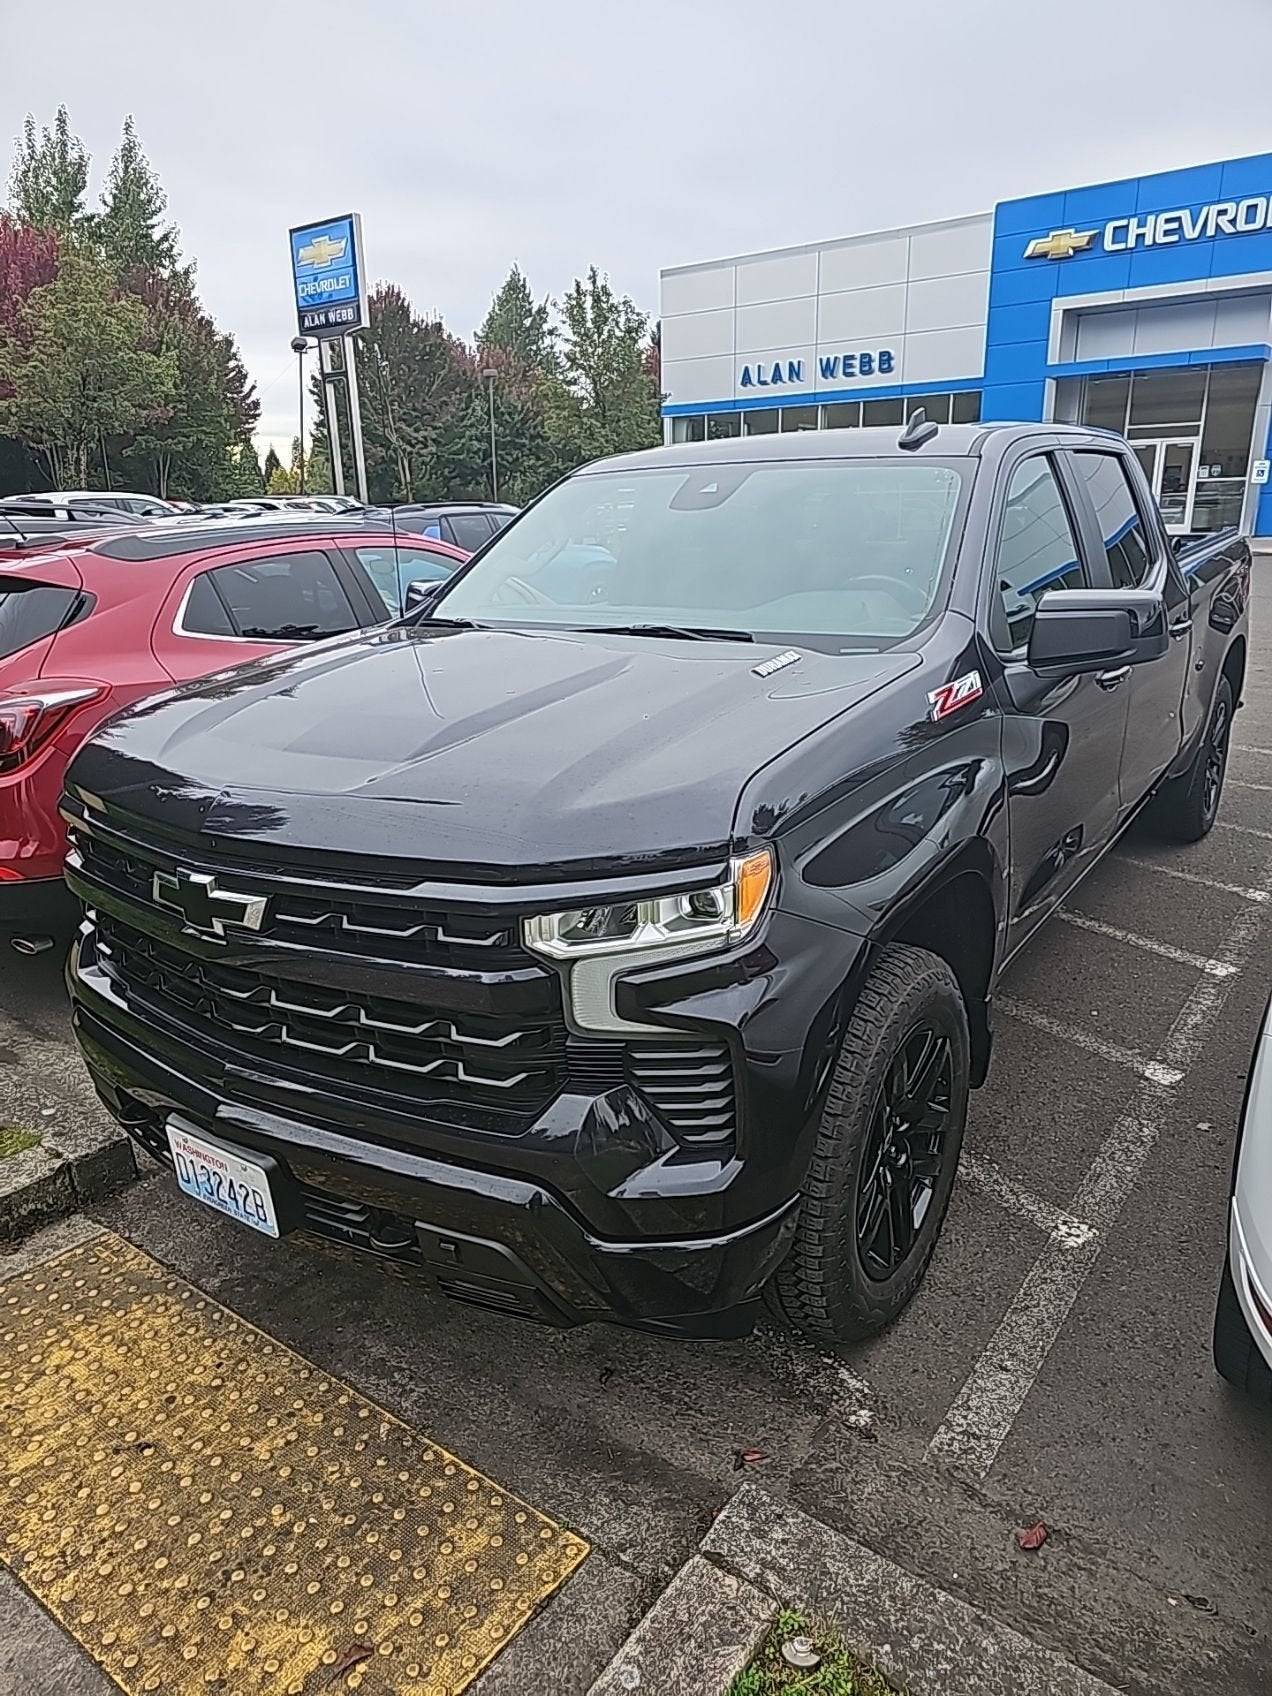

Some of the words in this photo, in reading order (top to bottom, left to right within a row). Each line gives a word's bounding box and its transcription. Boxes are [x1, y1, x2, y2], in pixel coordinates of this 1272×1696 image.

[1103, 195, 1272, 251] CHEVRO
[299, 274, 352, 297] CHEVROLET
[304, 313, 326, 329] ALAN
[328, 308, 354, 324] WEBB
[740, 359, 804, 388] ALAN
[819, 350, 895, 380] WEBB
[751, 650, 802, 678] DURAMAX
[927, 670, 983, 721] Z71
[174, 1139, 229, 1172] WASHINGTON
[175, 1152, 268, 1223] D13242B
